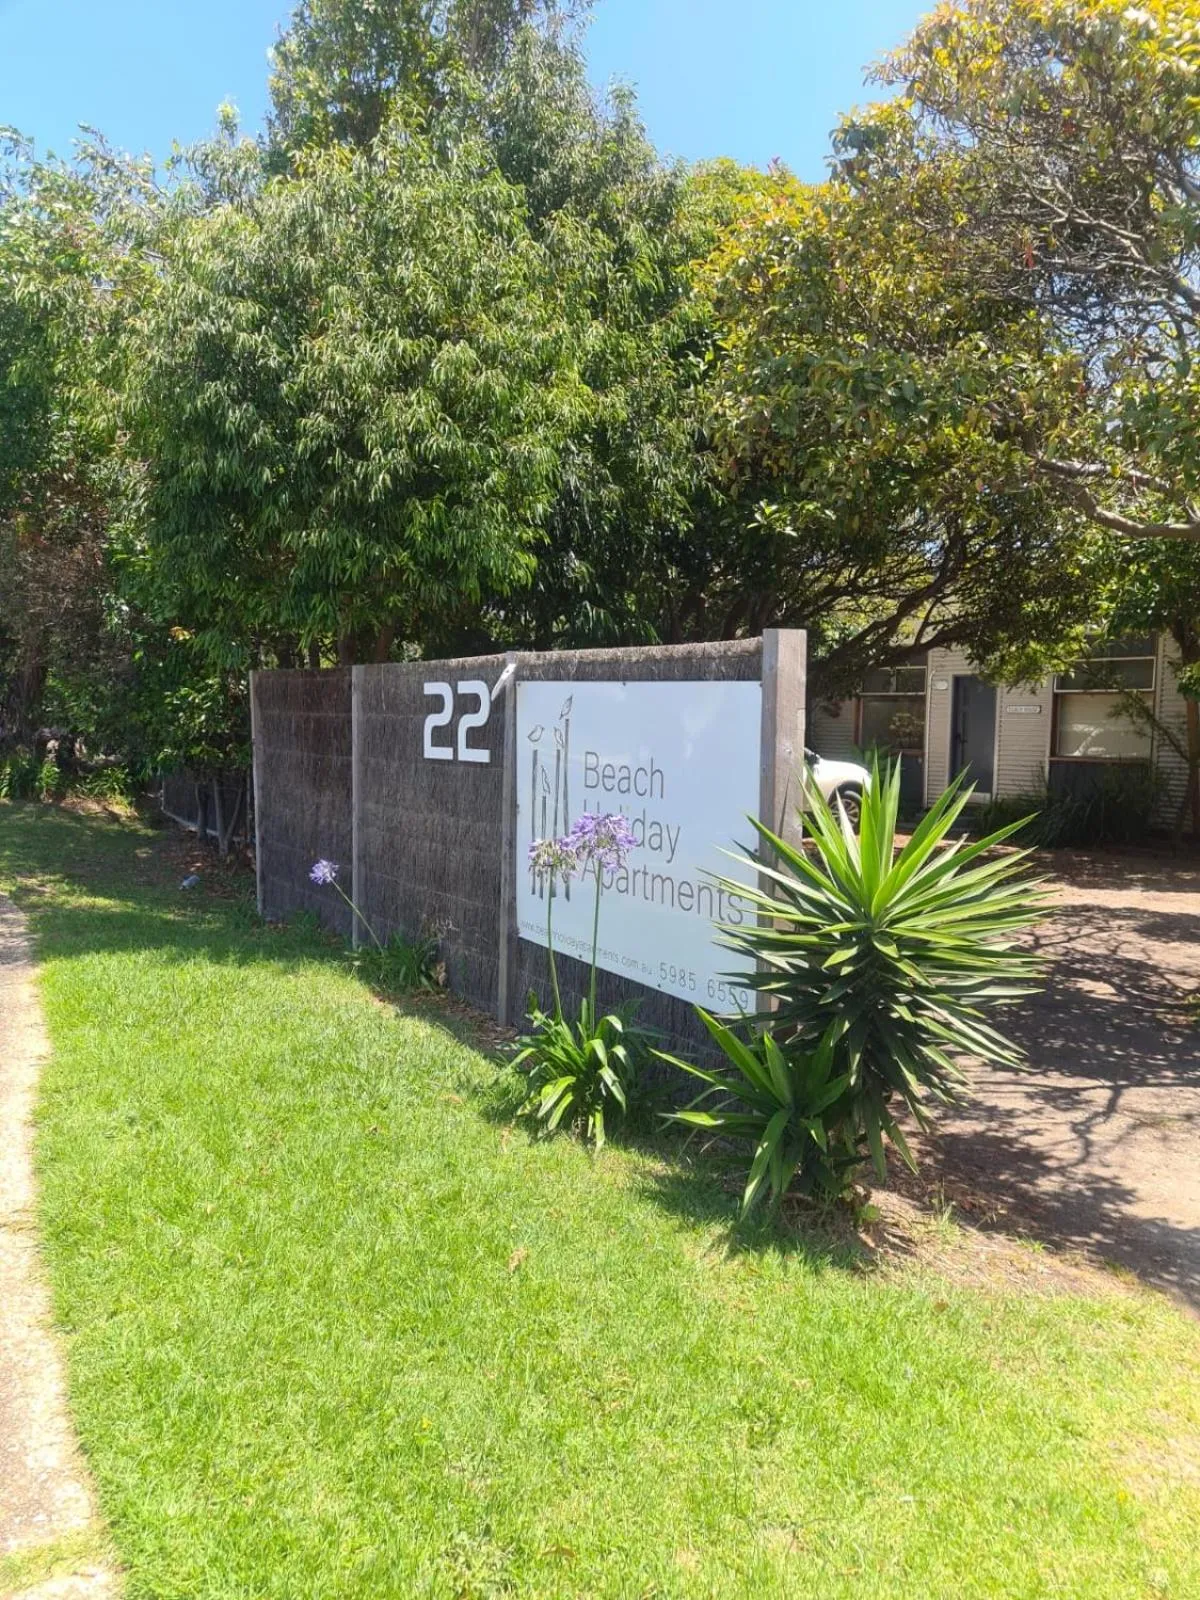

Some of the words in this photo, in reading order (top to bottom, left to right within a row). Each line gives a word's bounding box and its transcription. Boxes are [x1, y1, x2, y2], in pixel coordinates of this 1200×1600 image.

[423, 680, 491, 763] 22
[583, 751, 664, 799] Beach
[581, 847, 744, 925] Apartments
[659, 962, 697, 991] 5985
